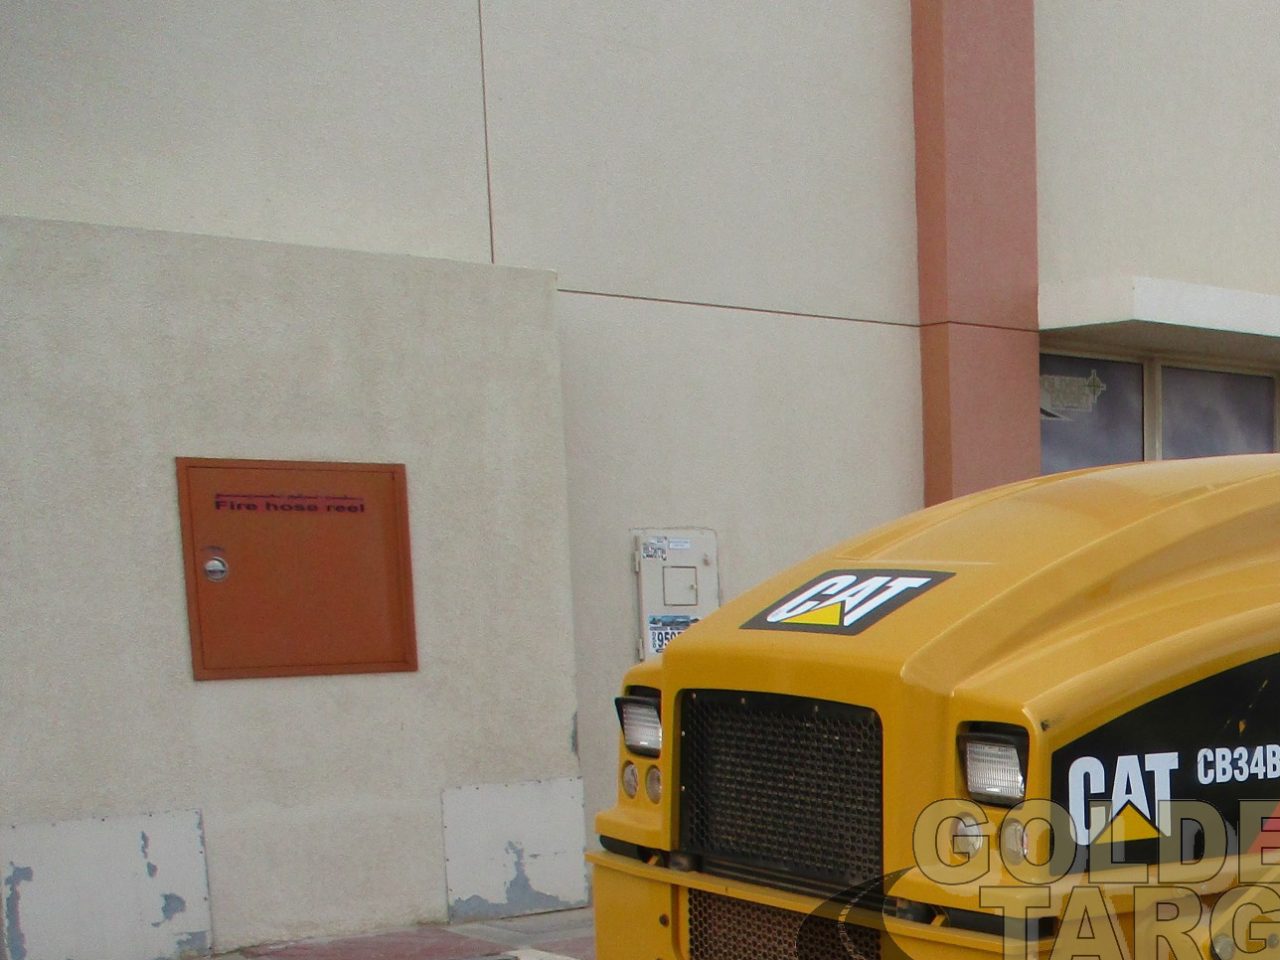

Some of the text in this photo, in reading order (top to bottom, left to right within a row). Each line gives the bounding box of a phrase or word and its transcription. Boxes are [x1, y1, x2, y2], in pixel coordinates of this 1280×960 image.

[215, 500, 365, 513] Fire hose reel
[766, 574, 932, 627] CAT
[1068, 752, 1179, 845] CAT
